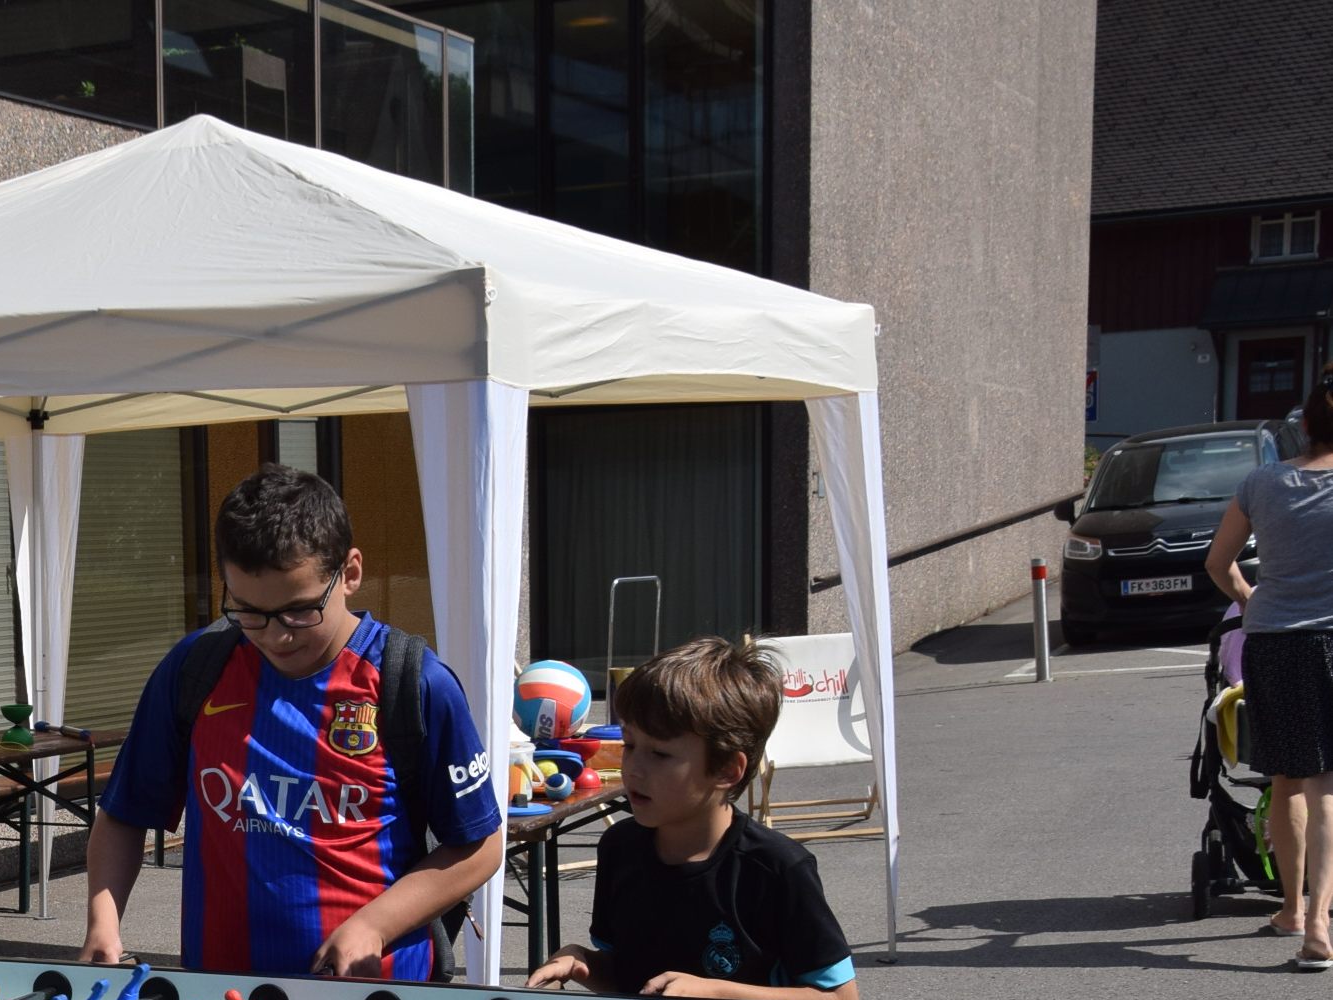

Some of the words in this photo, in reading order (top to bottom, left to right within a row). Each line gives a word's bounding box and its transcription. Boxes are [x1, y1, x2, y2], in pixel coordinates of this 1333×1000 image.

[1130, 582, 1144, 592] FK
[448, 751, 489, 784] beko
[200, 767, 369, 824] QATAR
[233, 817, 306, 839] AIRWAYS
